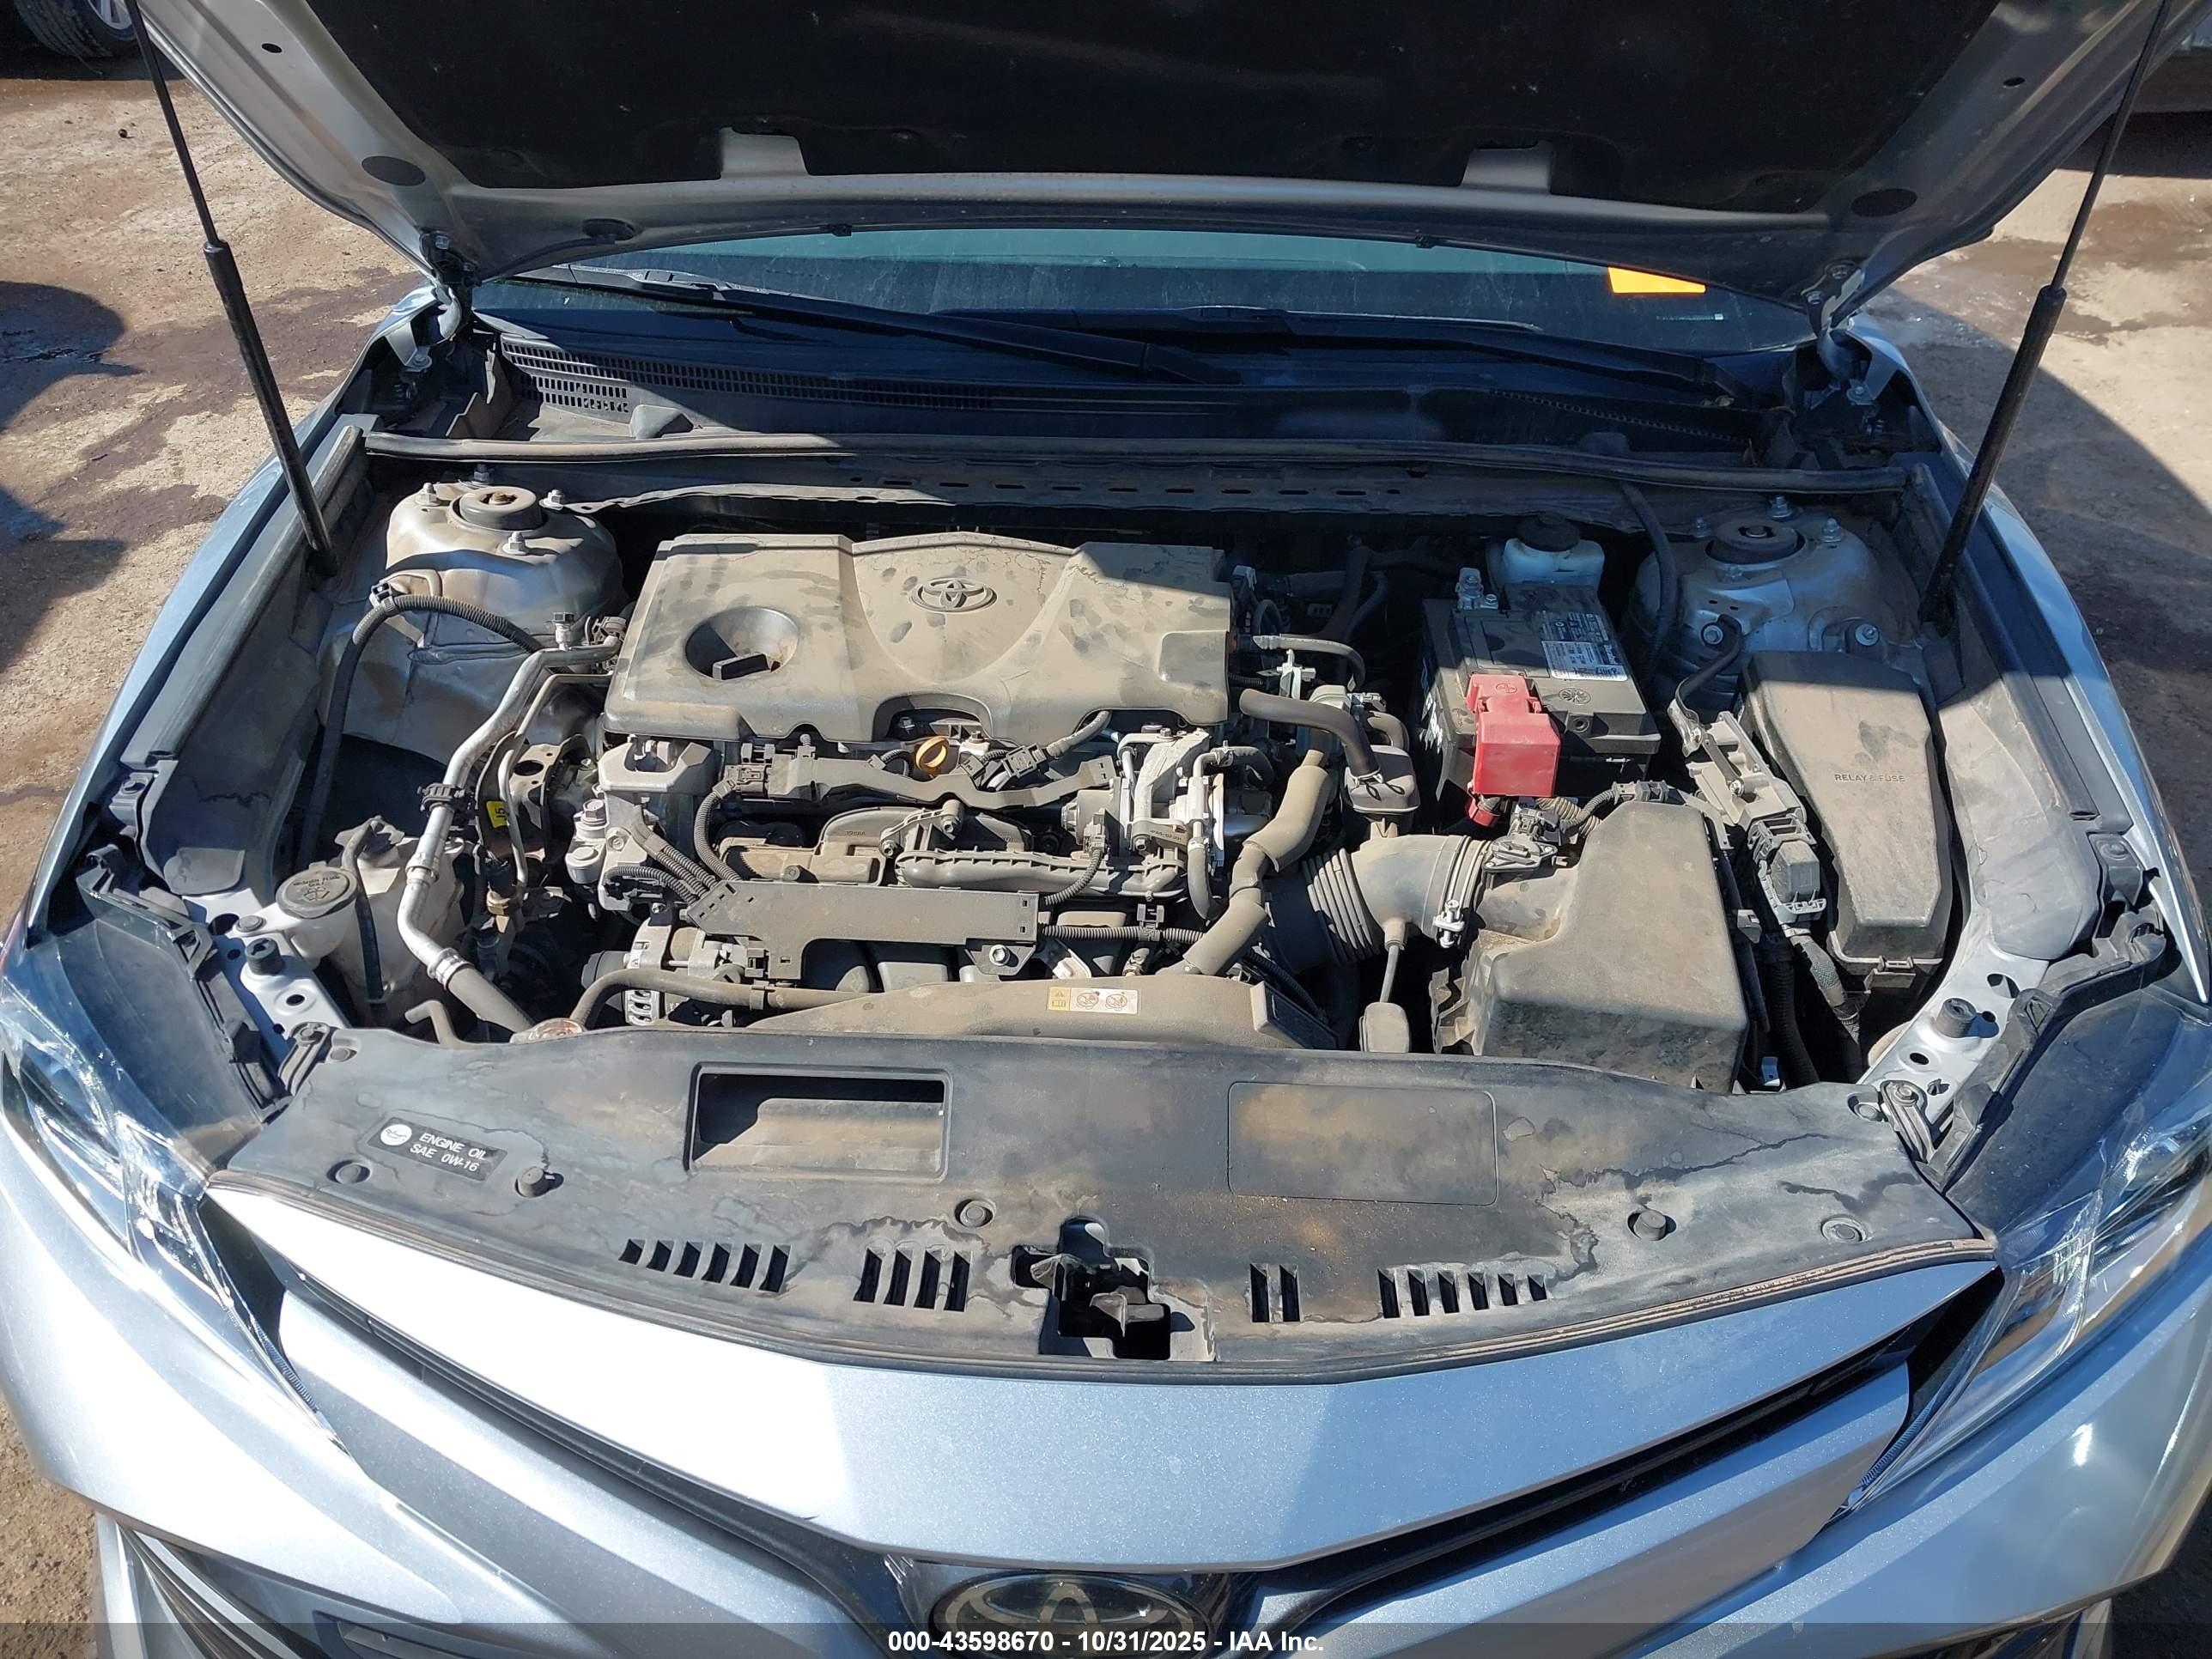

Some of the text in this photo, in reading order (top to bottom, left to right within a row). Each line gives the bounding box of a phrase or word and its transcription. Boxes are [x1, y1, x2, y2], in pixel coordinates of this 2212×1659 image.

[410, 1144, 480, 1171] SAE 0W-16
[419, 1133, 488, 1161] ENGINE OIL
